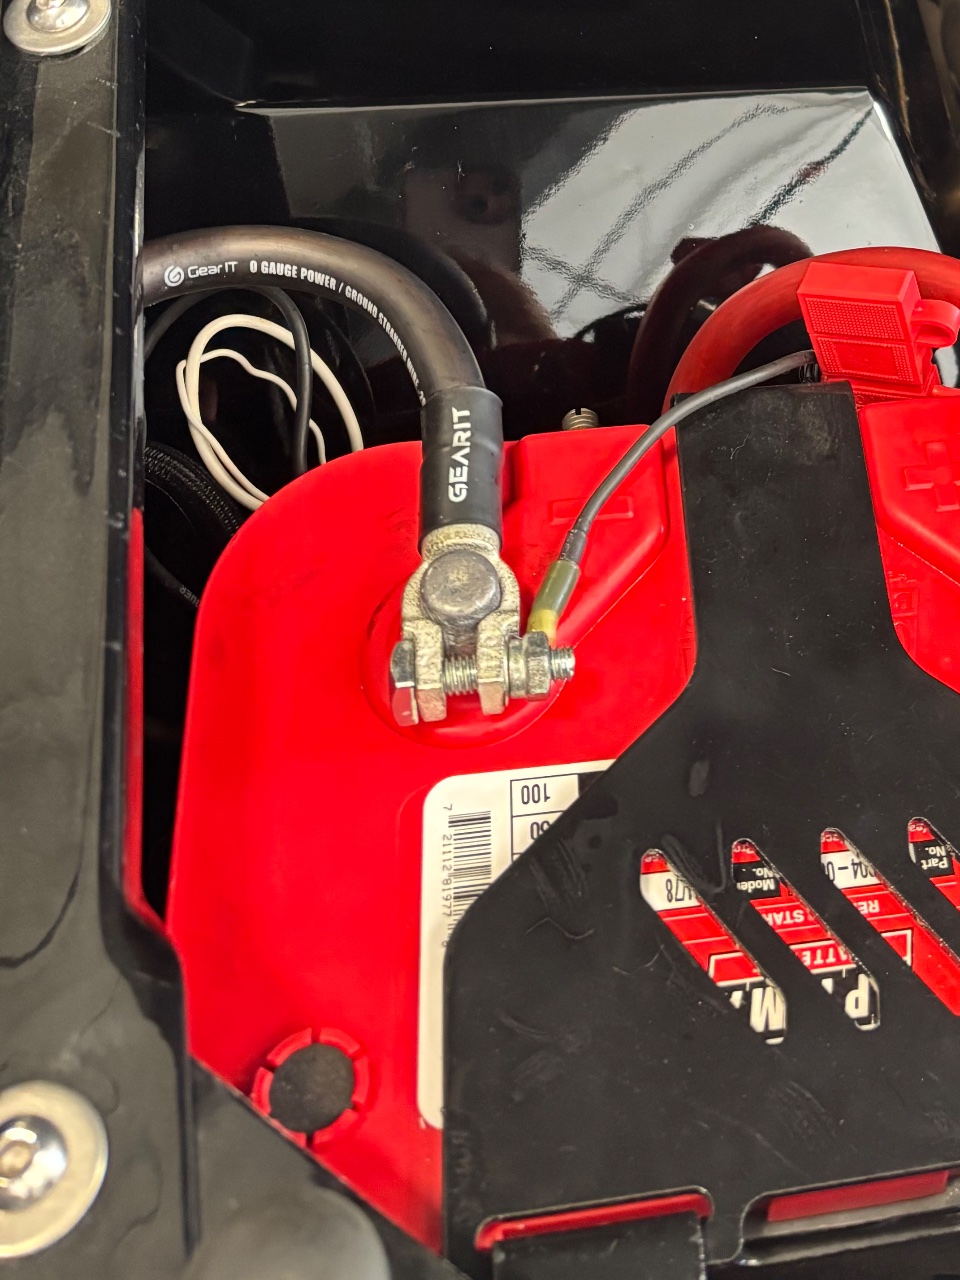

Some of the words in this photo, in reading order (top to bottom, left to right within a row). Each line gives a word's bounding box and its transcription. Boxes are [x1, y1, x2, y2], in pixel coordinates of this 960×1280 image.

[260, 261, 298, 278] GAUGE
[300, 267, 337, 291] POWER
[345, 285, 378, 319] GROUND
[448, 407, 470, 503] GEARIT
[520, 783, 551, 805] 100
[442, 834, 452, 872] 21112
[920, 857, 949, 870] Part
[925, 845, 947, 857] No.
[441, 878, 452, 917] 81977
